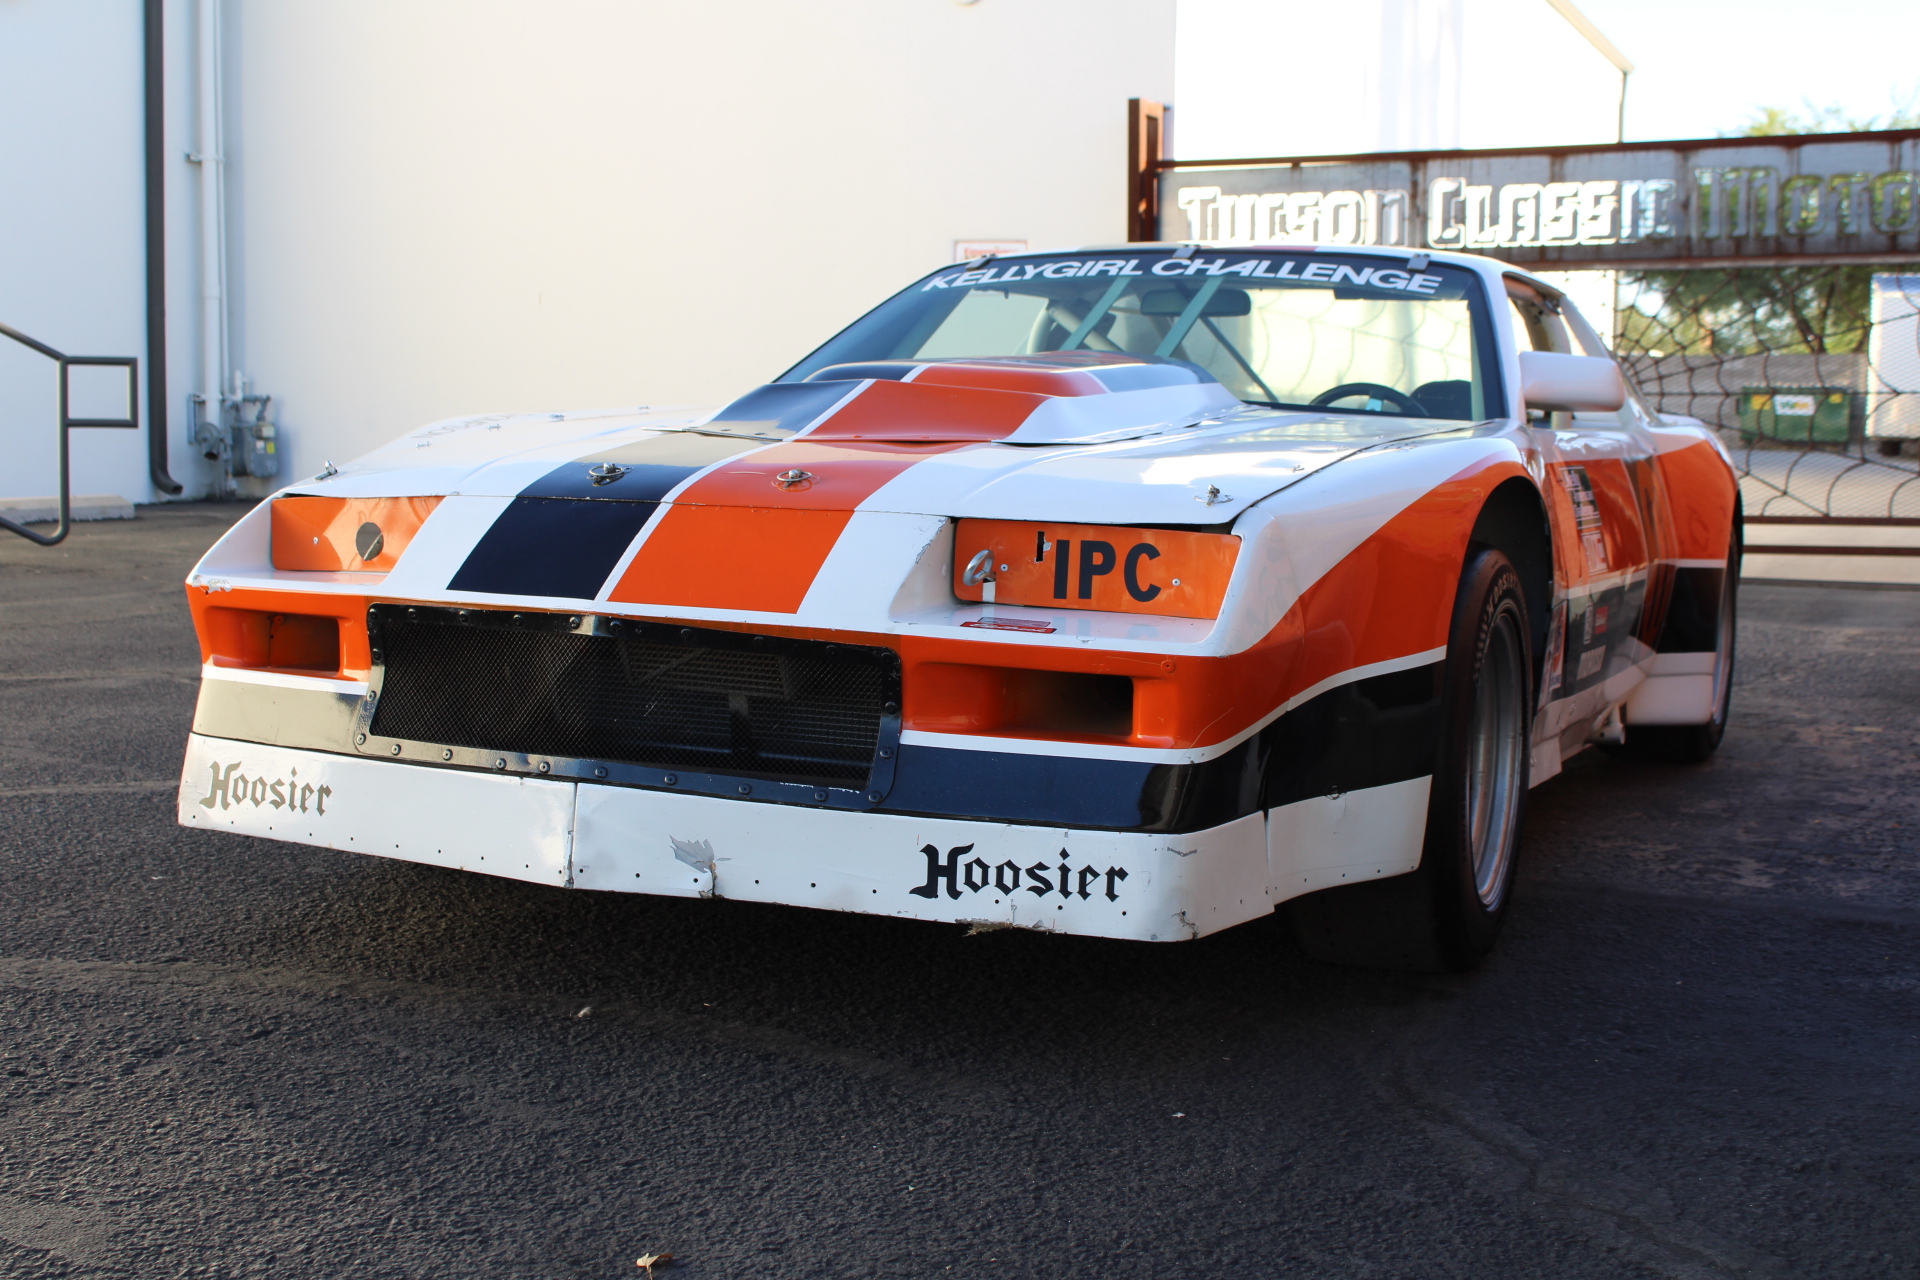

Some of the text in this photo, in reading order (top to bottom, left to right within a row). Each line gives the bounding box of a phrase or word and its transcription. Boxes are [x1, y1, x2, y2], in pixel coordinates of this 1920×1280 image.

[921, 258, 1443, 294] KELLYGIRL CHALLENGE
[1053, 539, 1162, 602] IPC
[199, 760, 333, 817] Hoosier
[908, 842, 1129, 903] Hoosier
